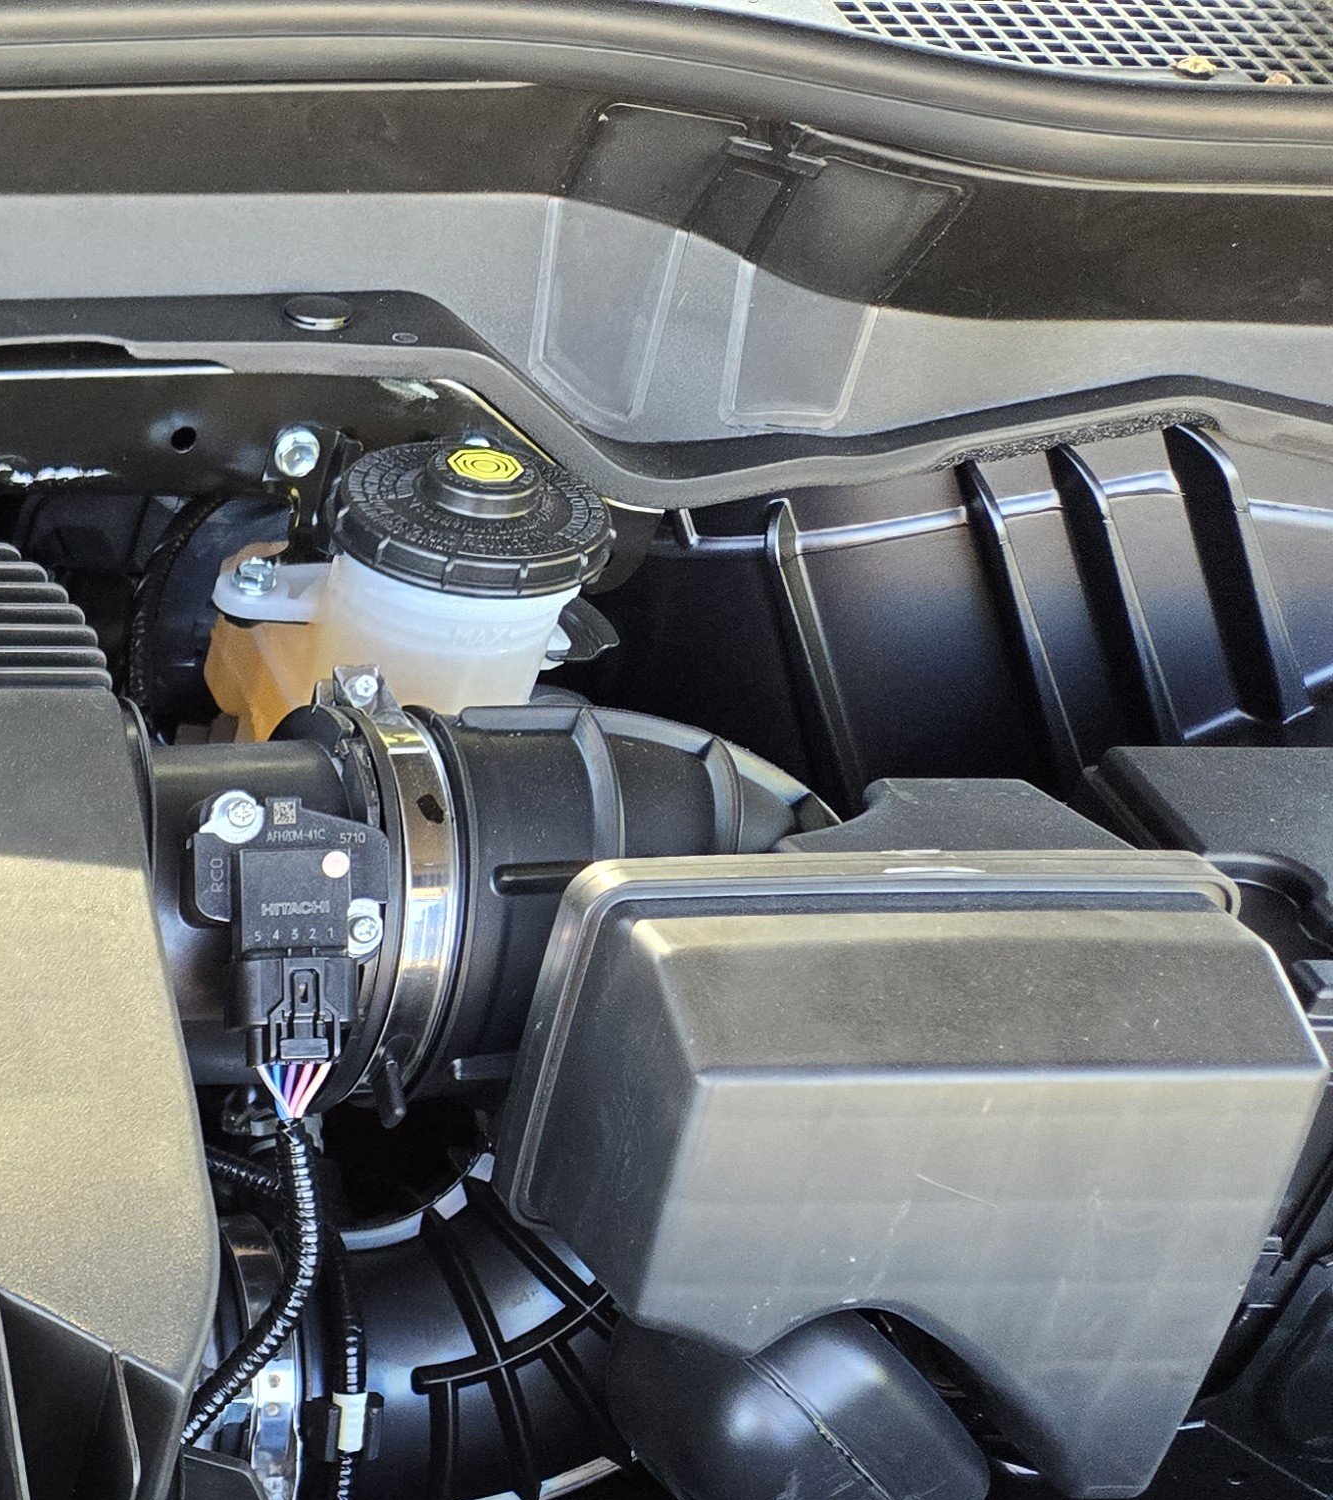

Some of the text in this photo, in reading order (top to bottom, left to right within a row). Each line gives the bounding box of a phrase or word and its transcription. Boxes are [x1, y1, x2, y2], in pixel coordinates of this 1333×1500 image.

[452, 626, 509, 648] MAX
[339, 831, 366, 845] 5710
[261, 901, 330, 917] HITACHI
[254, 931, 262, 942] 5
[272, 929, 280, 941] 4
[291, 929, 299, 940] 3
[309, 929, 317, 939] 2
